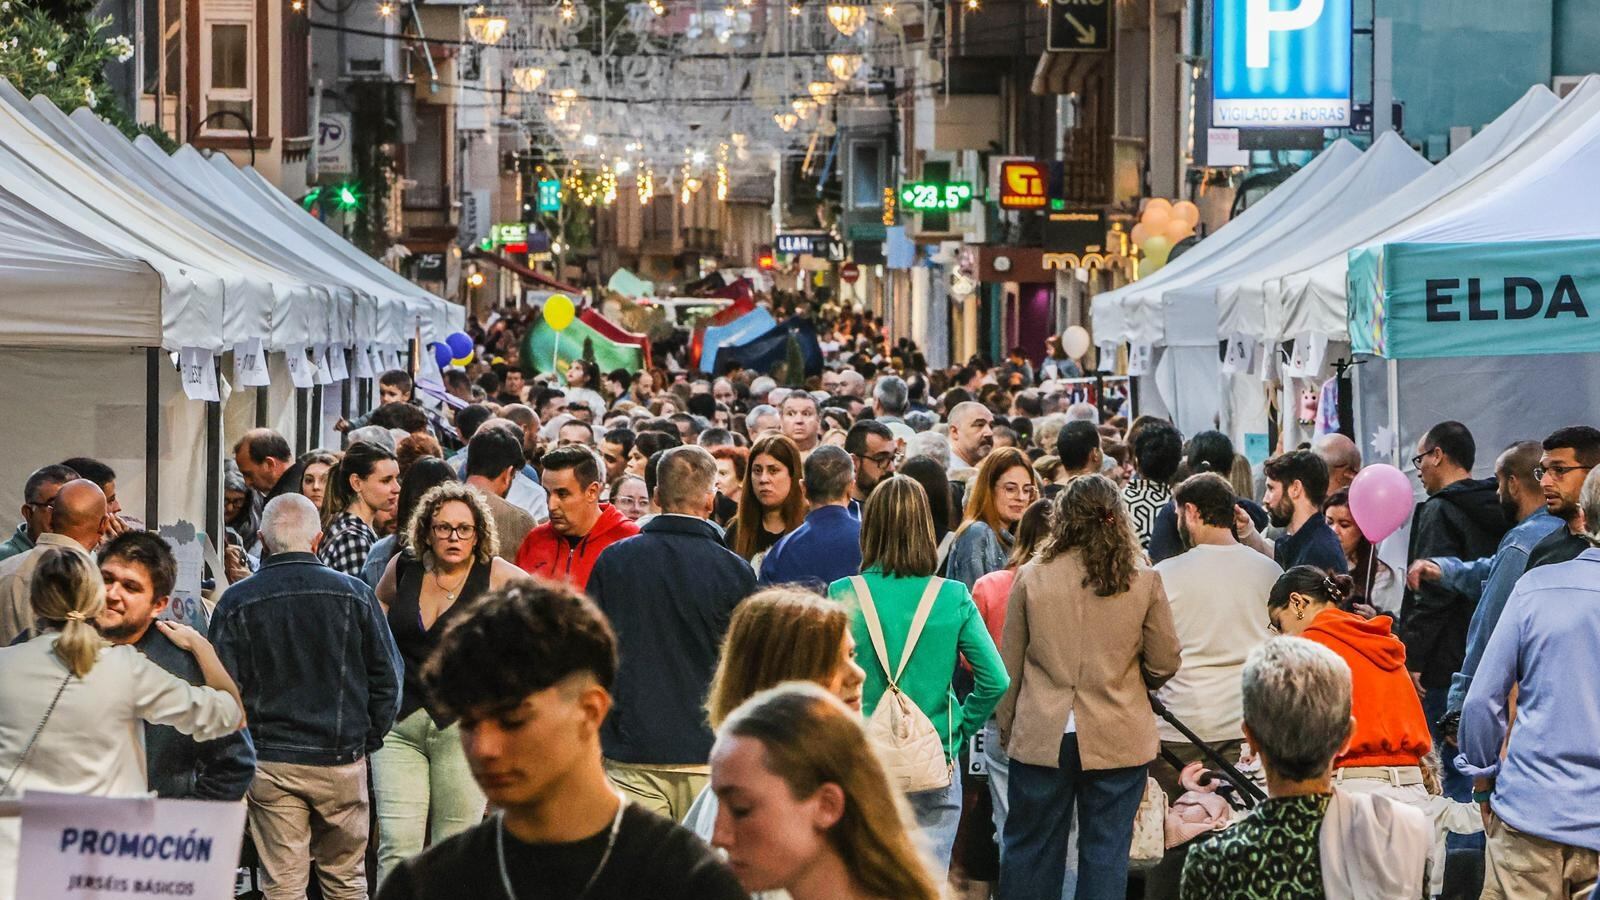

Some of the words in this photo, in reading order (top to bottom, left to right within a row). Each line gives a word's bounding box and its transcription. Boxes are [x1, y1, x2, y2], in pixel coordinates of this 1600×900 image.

[1219, 106, 1280, 121] VIGILADO
[1284, 107, 1297, 121] 24
[1300, 107, 1345, 121] HORAS
[1425, 274, 1590, 323] ELDA
[60, 827, 213, 862] PROMOCIÓN
[67, 873, 128, 893] JERSÉIS
[132, 877, 196, 897] BÁSICOS
